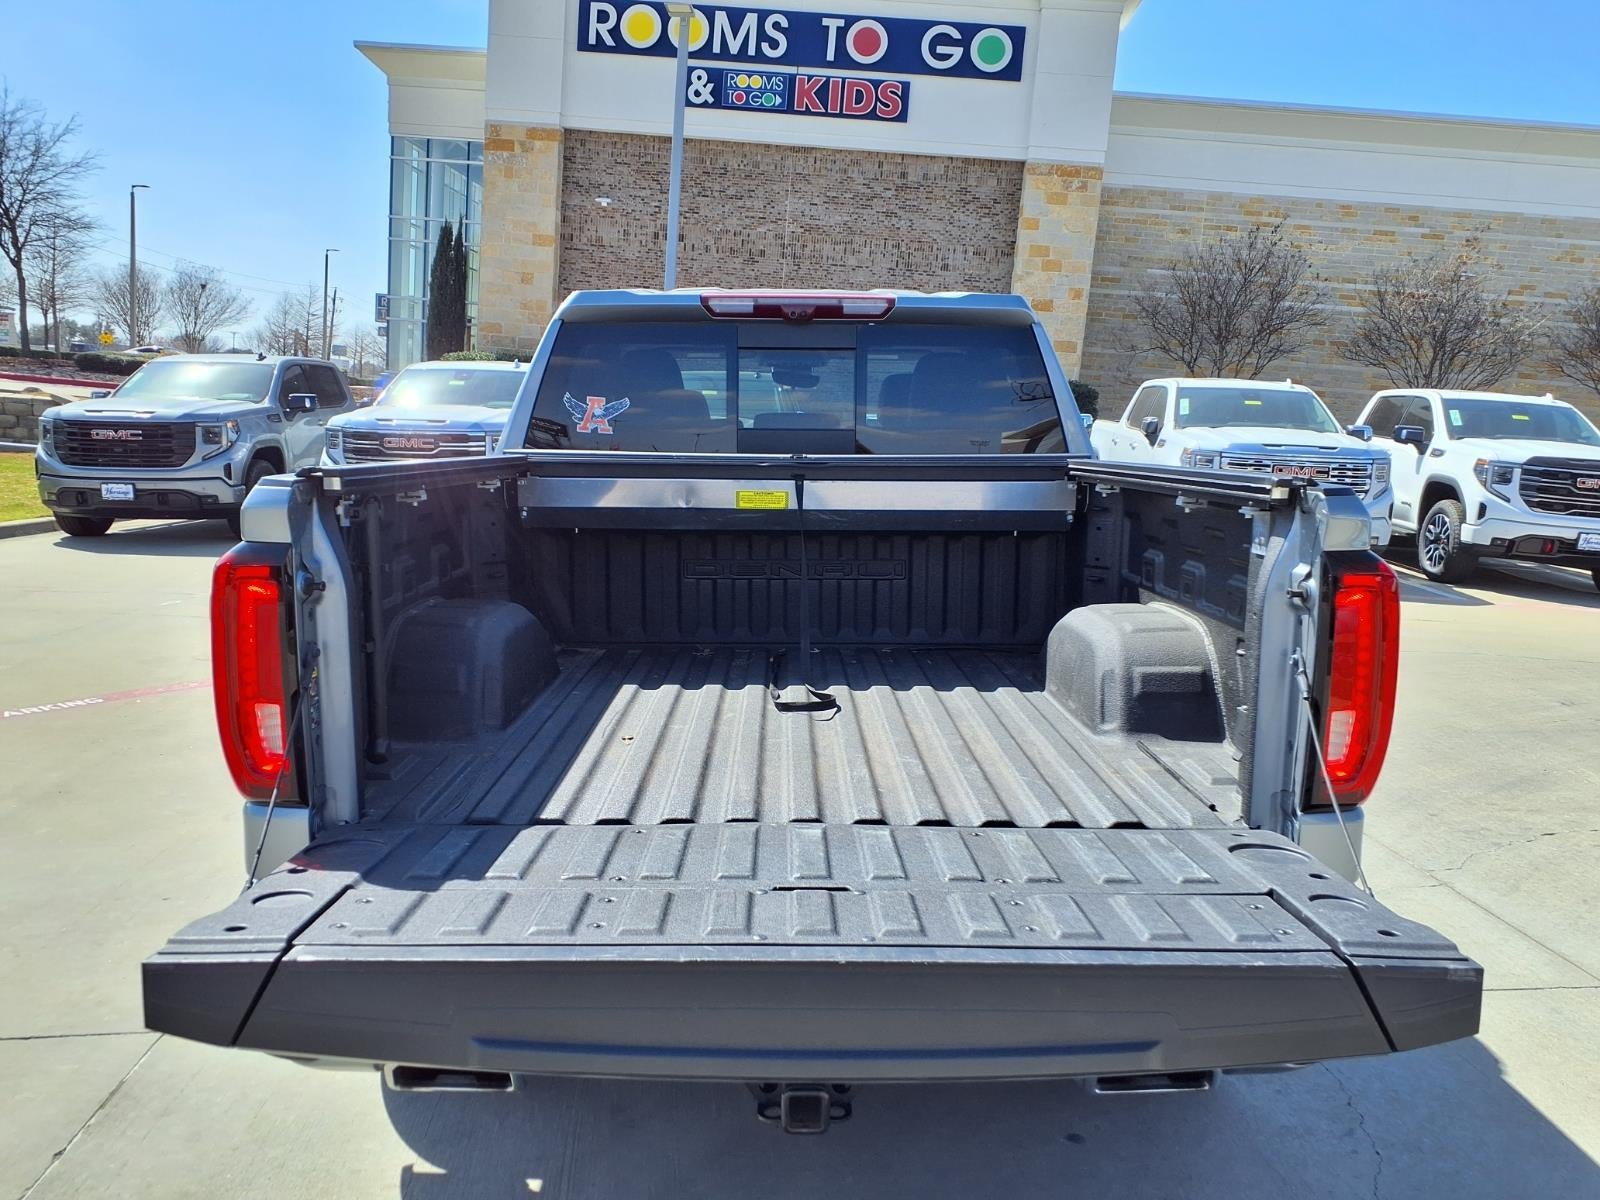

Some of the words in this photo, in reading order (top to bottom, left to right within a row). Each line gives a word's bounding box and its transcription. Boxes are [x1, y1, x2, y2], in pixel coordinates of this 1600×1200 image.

[588, 2, 789, 58] ROOMS
[822, 17, 889, 64] TO
[921, 24, 1013, 73] GO
[687, 69, 715, 104] &
[727, 73, 784, 91] ROOMS
[727, 90, 746, 104] TO
[749, 91, 775, 106] GO
[794, 75, 902, 118] KIDS
[91, 429, 143, 440] GMC
[384, 437, 435, 448] GMC
[1273, 465, 1329, 479] GMC
